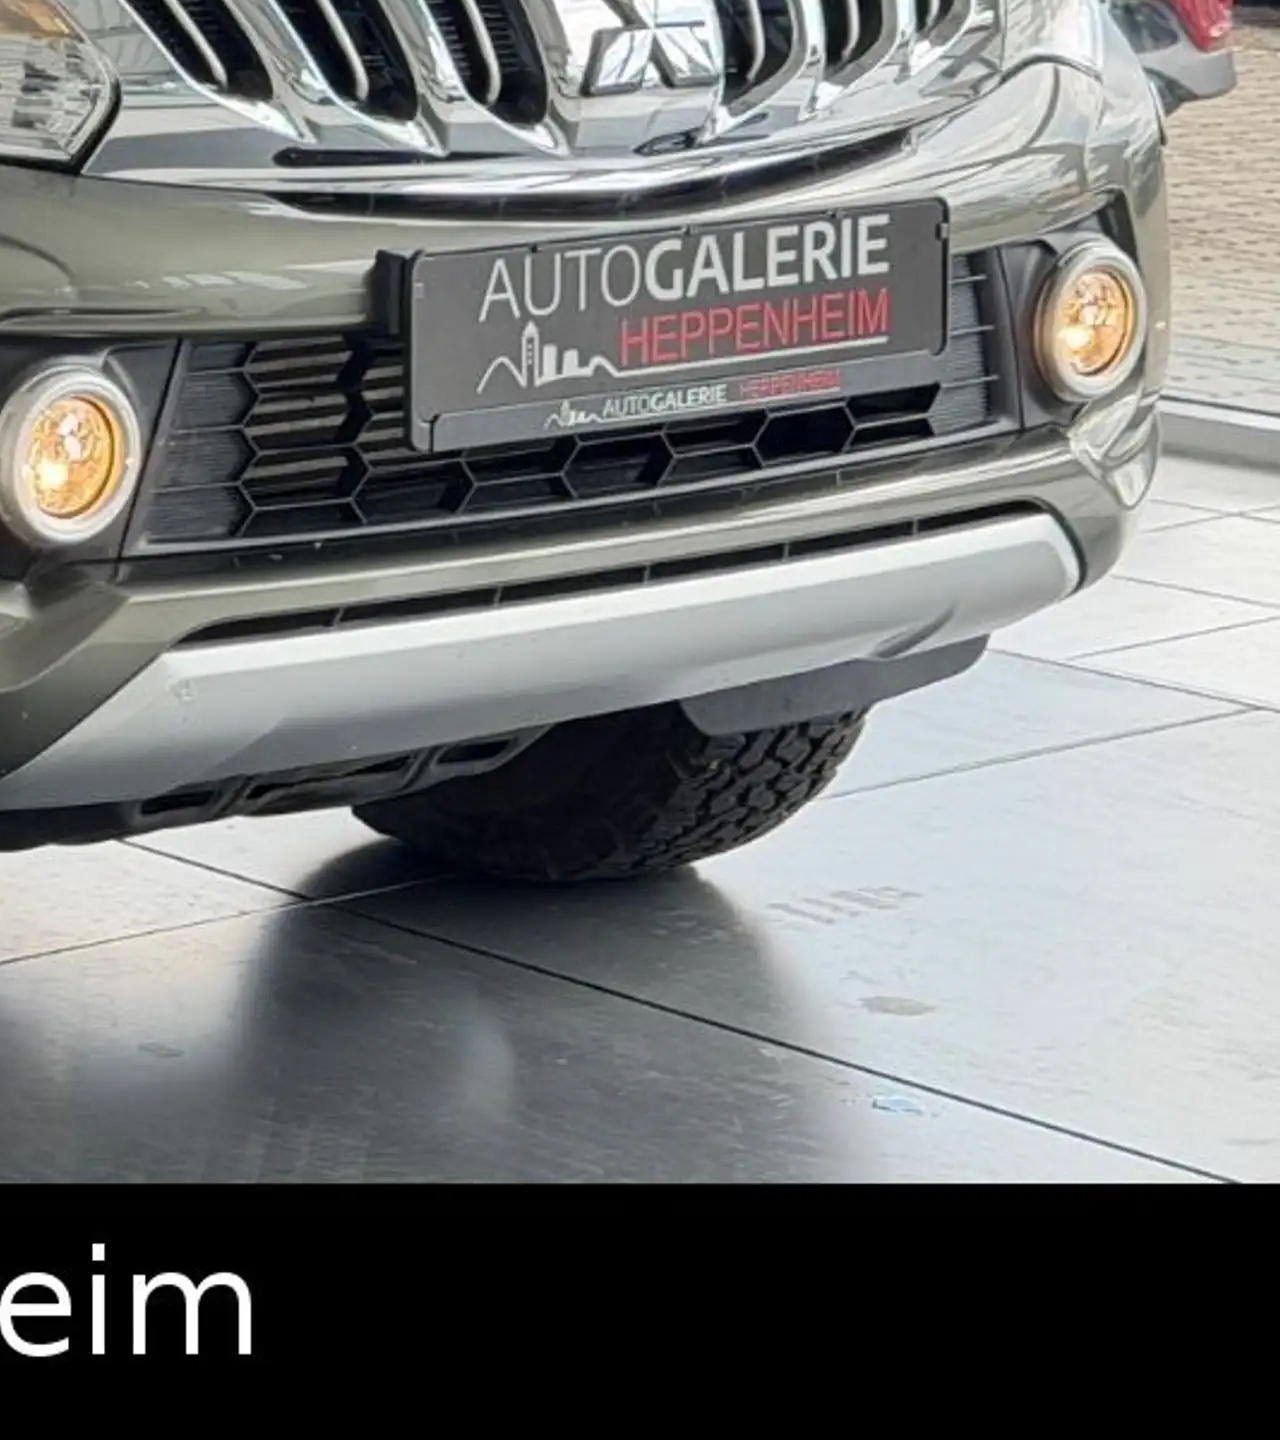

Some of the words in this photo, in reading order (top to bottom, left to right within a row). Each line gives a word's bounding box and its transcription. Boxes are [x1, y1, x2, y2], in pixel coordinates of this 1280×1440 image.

[478, 213, 891, 323] AUTOGALERIE
[619, 287, 891, 367] HEPPENHEIM
[601, 383, 729, 417] AUTOGALERIE
